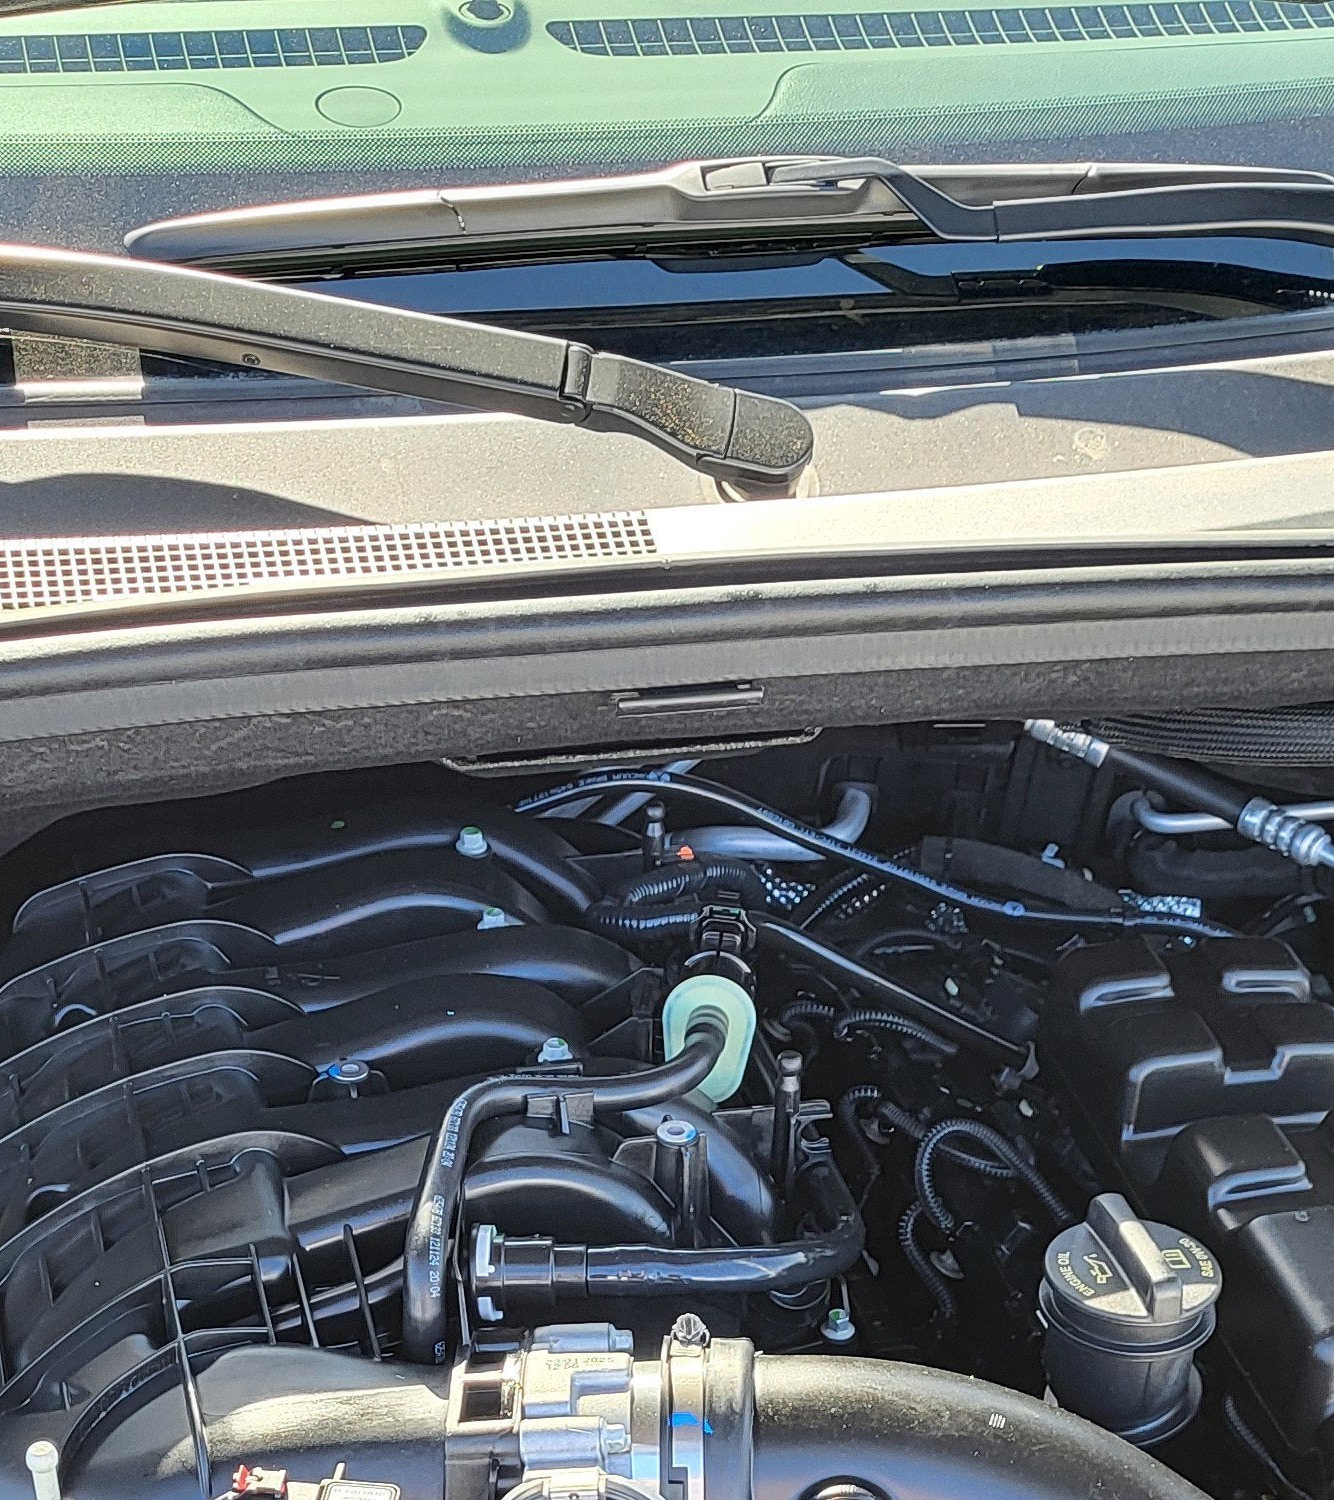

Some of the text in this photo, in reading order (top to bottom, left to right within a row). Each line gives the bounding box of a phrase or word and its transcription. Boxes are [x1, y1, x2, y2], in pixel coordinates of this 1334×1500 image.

[1057, 1251, 1096, 1297] ENGINE OIL
[1198, 1259, 1215, 1278] SAE
